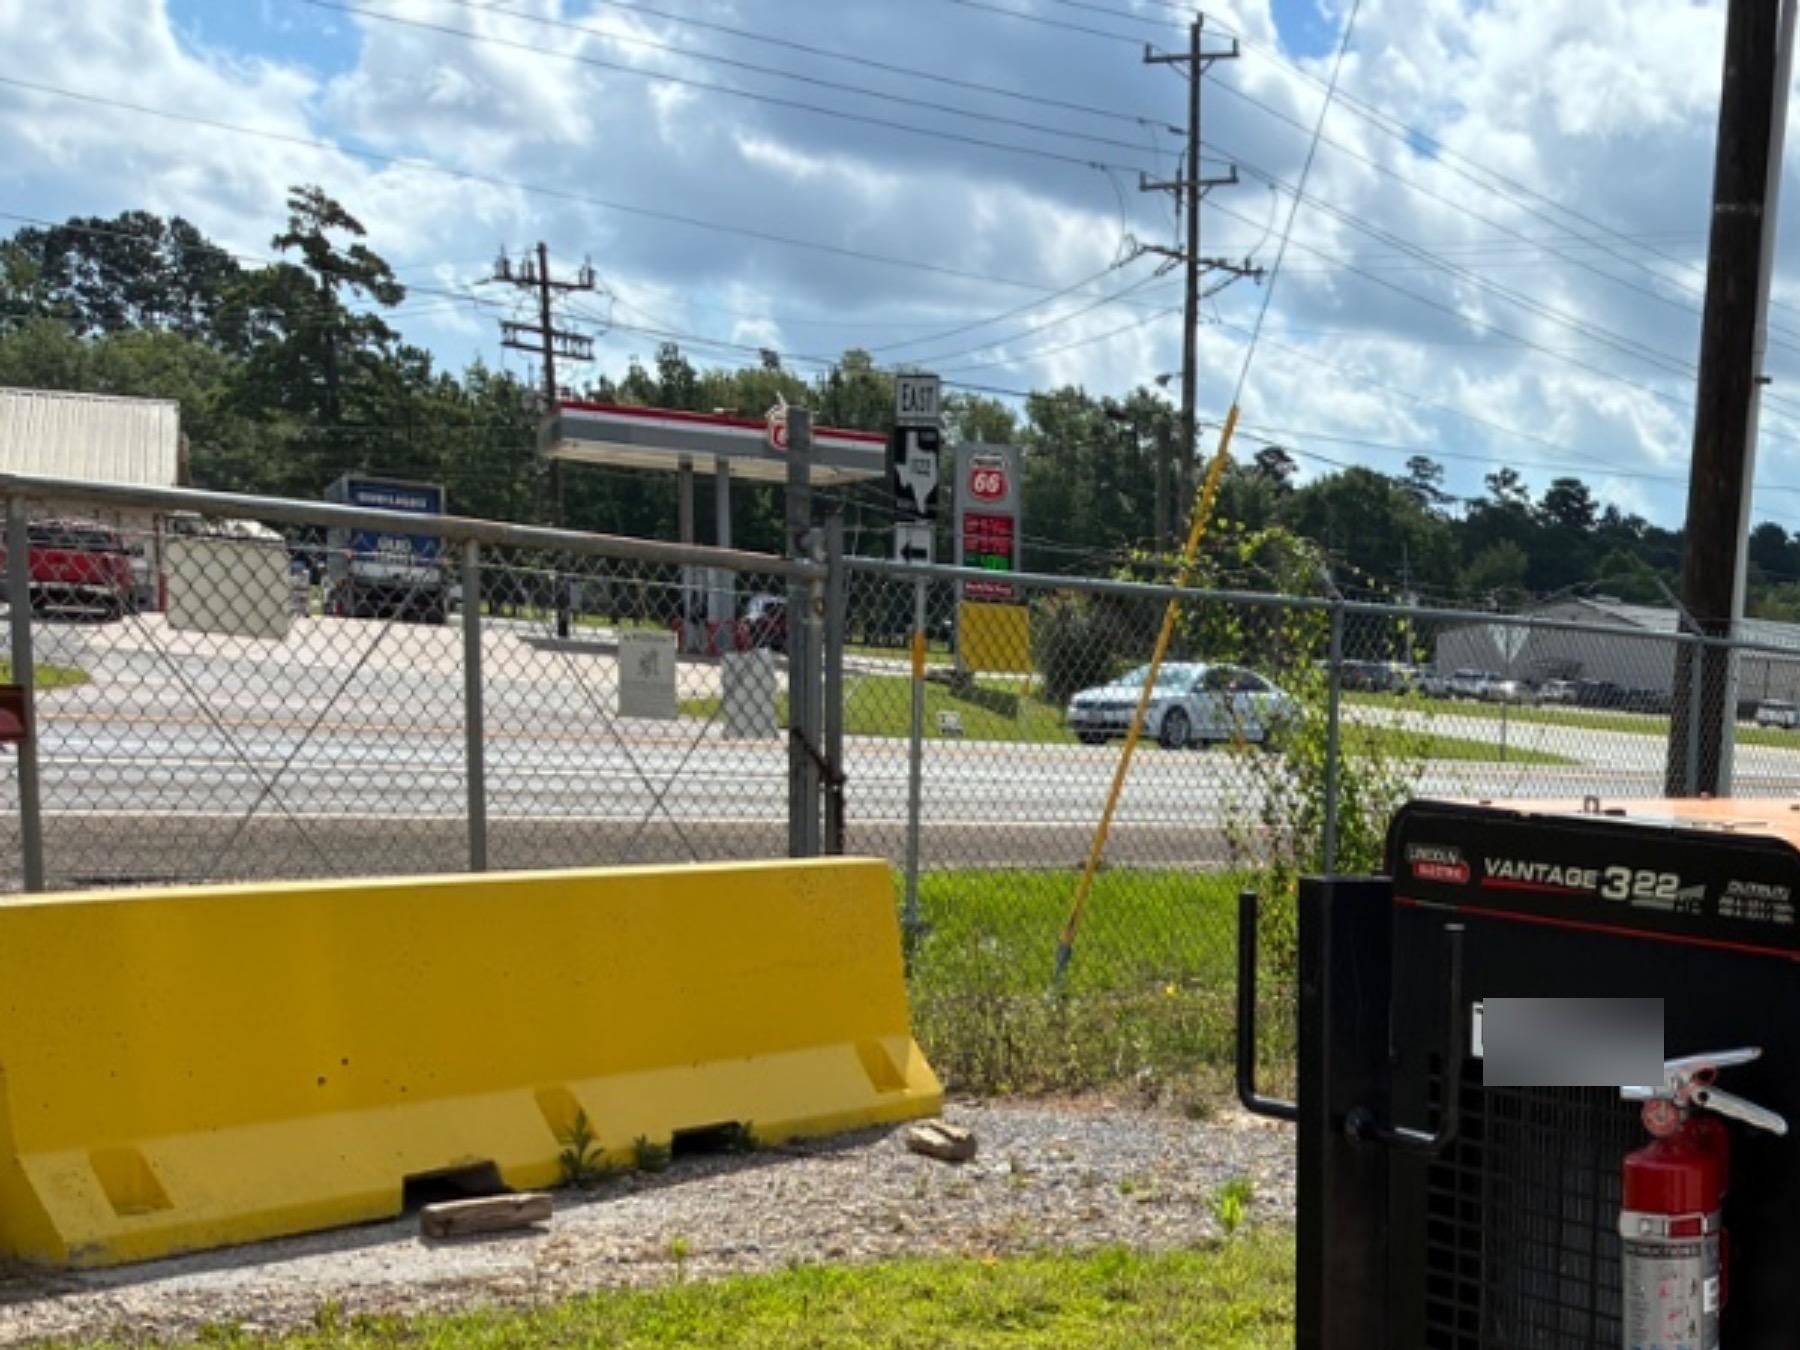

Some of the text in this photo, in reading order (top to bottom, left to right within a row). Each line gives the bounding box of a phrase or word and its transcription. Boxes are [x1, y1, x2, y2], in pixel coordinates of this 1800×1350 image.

[974, 472, 1000, 493] 66
[1484, 857, 1681, 900] VANTAGE 322
